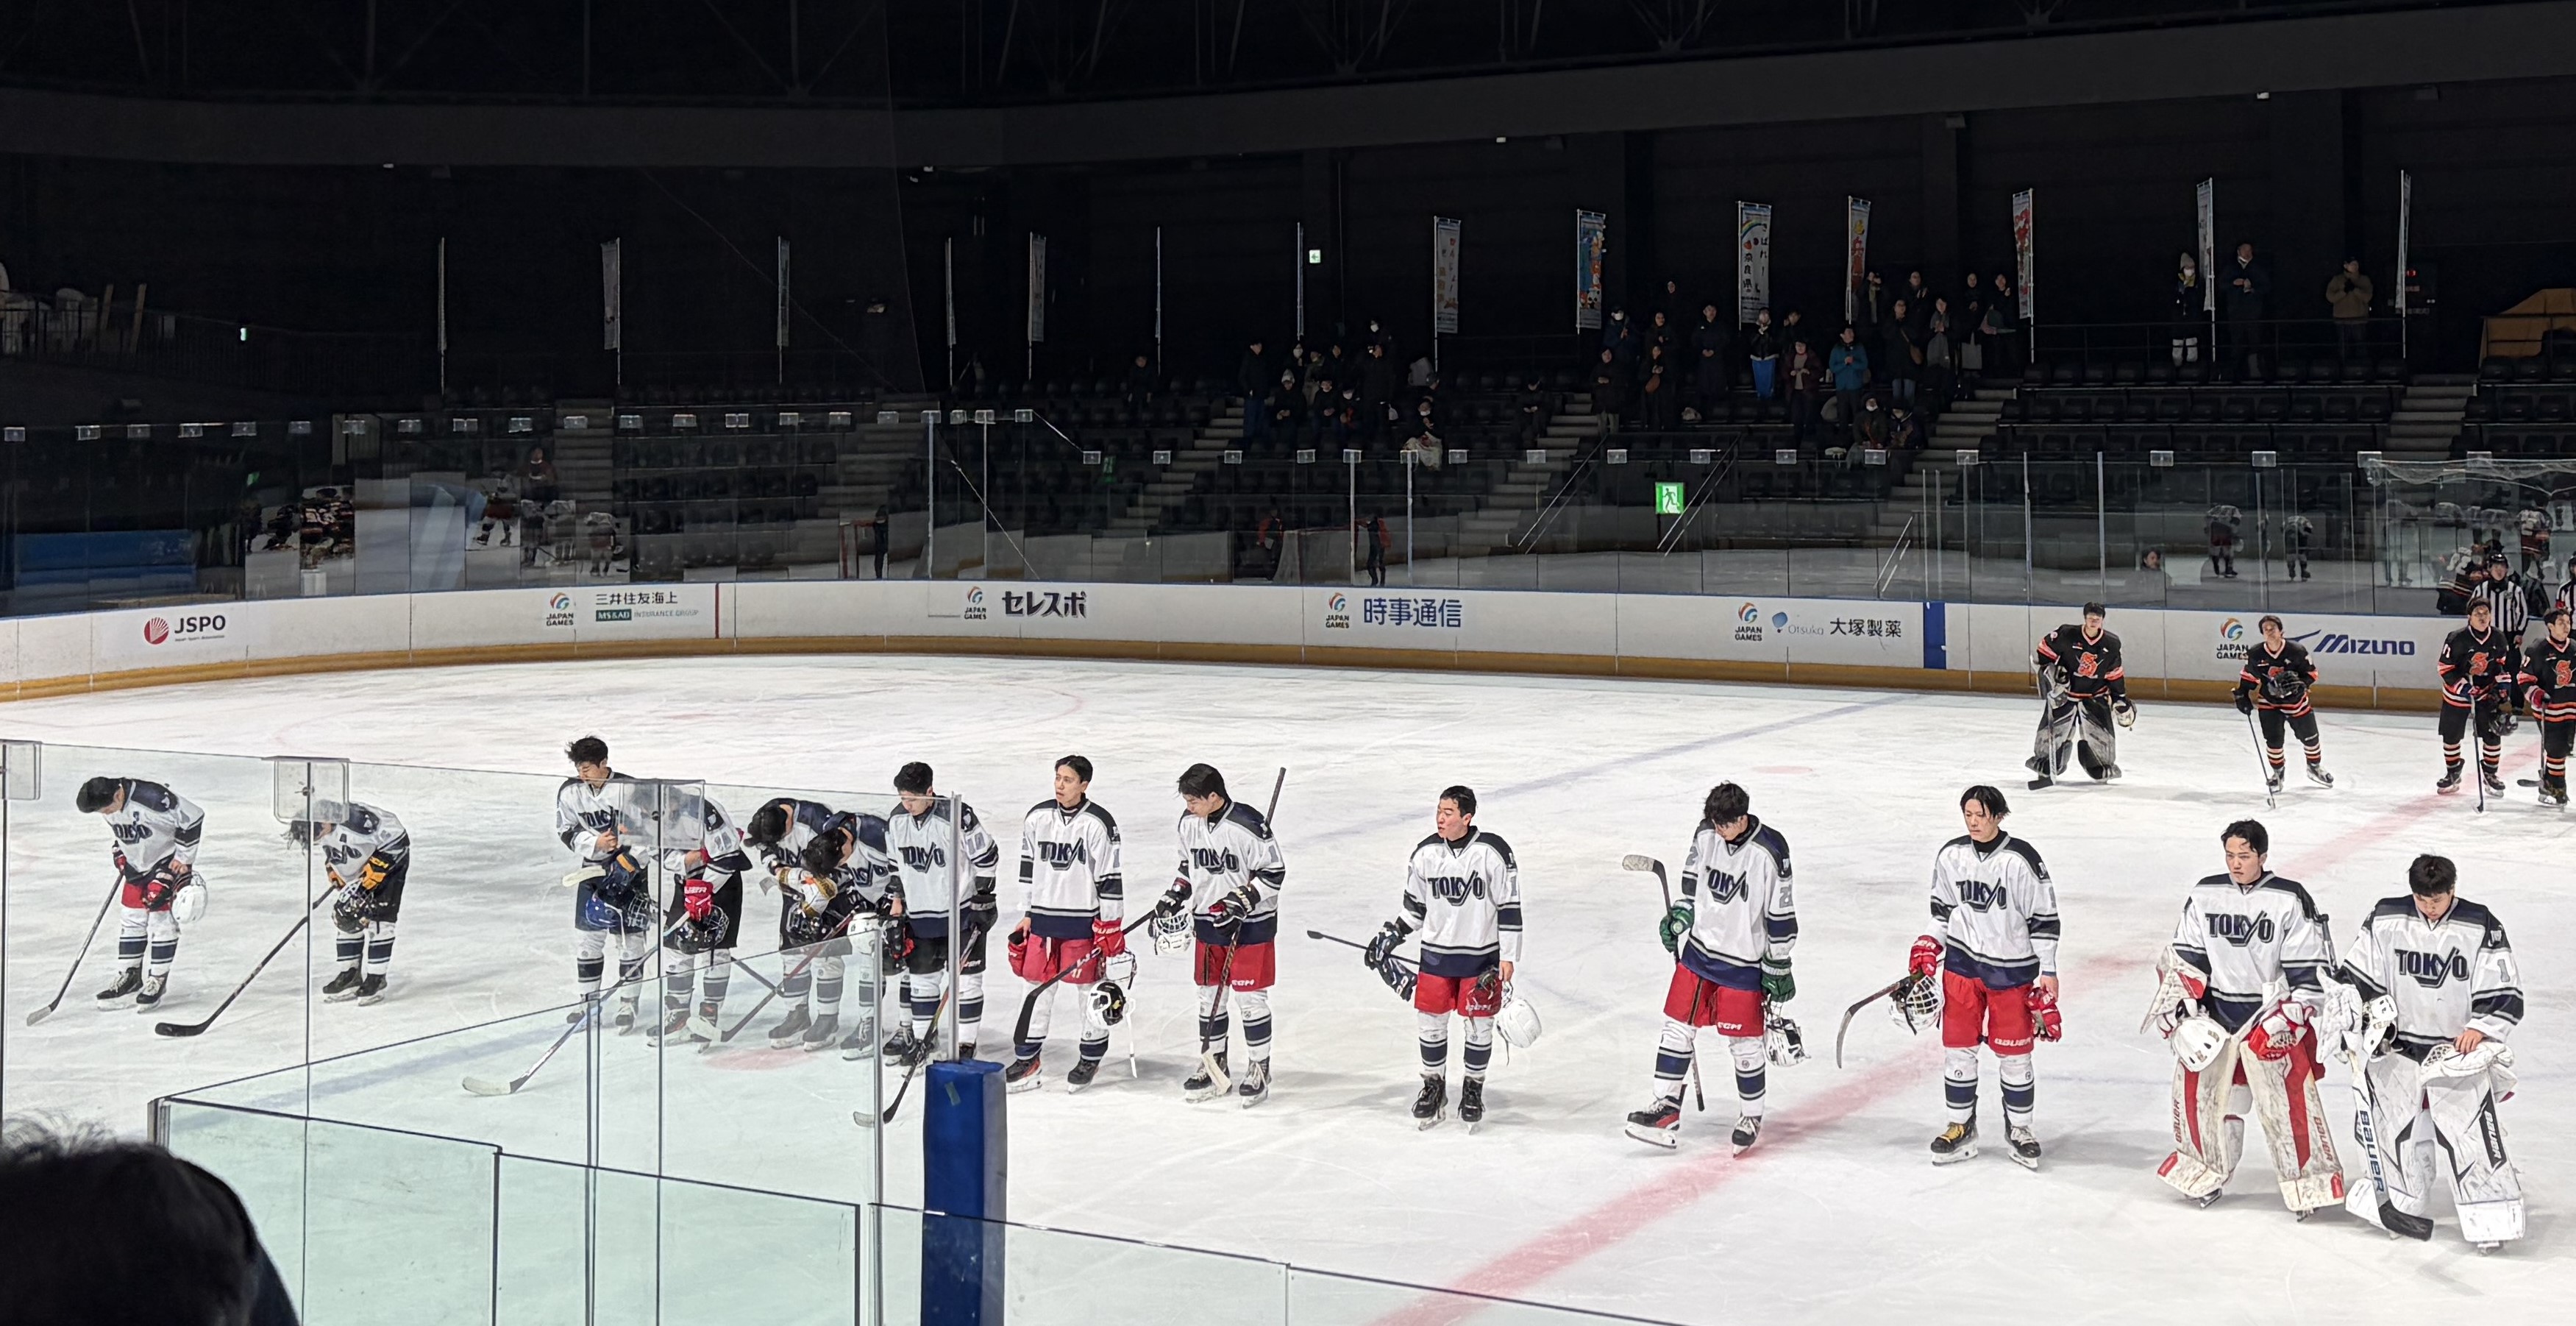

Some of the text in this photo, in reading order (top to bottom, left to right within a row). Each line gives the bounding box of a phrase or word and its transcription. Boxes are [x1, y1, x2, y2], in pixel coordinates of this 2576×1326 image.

[1743, 252, 1754, 288] 奈良県
[595, 591, 678, 606] 三井住友海上
[1001, 590, 1087, 619] セレスポ
[1363, 597, 1463, 628] 時事通信
[174, 614, 227, 634] JSPO
[598, 610, 630, 620] MS&AD
[1829, 617, 1902, 638] 大塚製薬
[1734, 626, 1762, 634] JAPAN
[1734, 634, 1762, 642] GAMES
[2216, 643, 2249, 652] JAPAN
[2216, 651, 2249, 661] GAMES
[1427, 870, 1486, 907] TOKYO
[1705, 865, 1749, 905] OKYO
[2205, 910, 2276, 948] TOKYO
[2394, 946, 2470, 990] TOKYO
[2497, 958, 2511, 983] 1
[2313, 1116, 2333, 1162] BAUER
[2484, 1110, 2502, 1160] BAUER
[2359, 1109, 2385, 1192] BAUER
